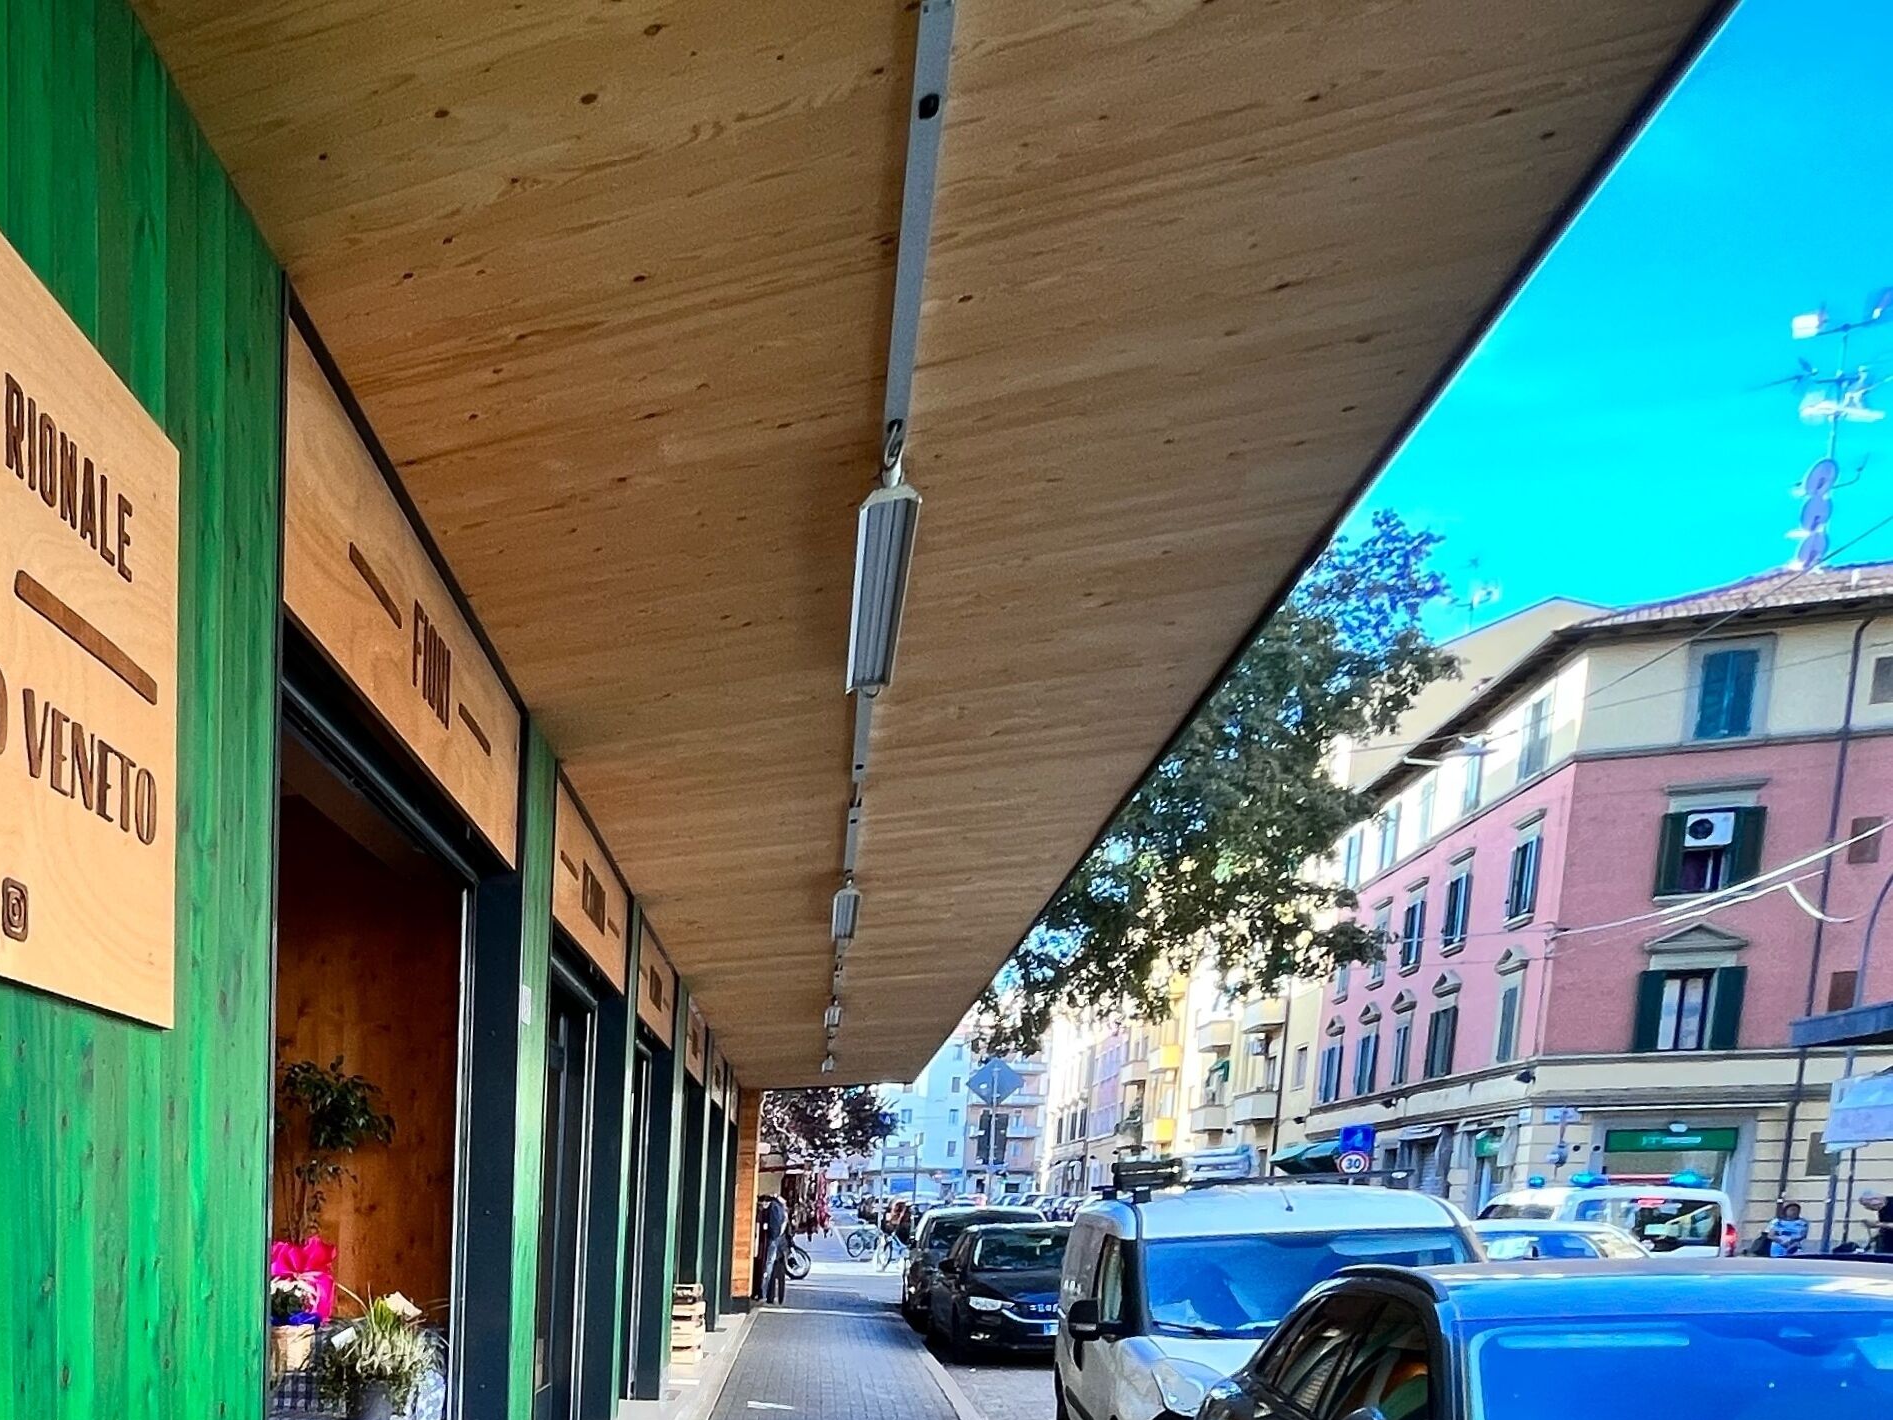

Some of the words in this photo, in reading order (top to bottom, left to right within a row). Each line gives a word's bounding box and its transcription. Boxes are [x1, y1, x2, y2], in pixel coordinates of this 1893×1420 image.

[4, 371, 133, 583] RIONALE
[21, 687, 158, 846] VENETO
[1345, 1158, 1361, 1169] 30
